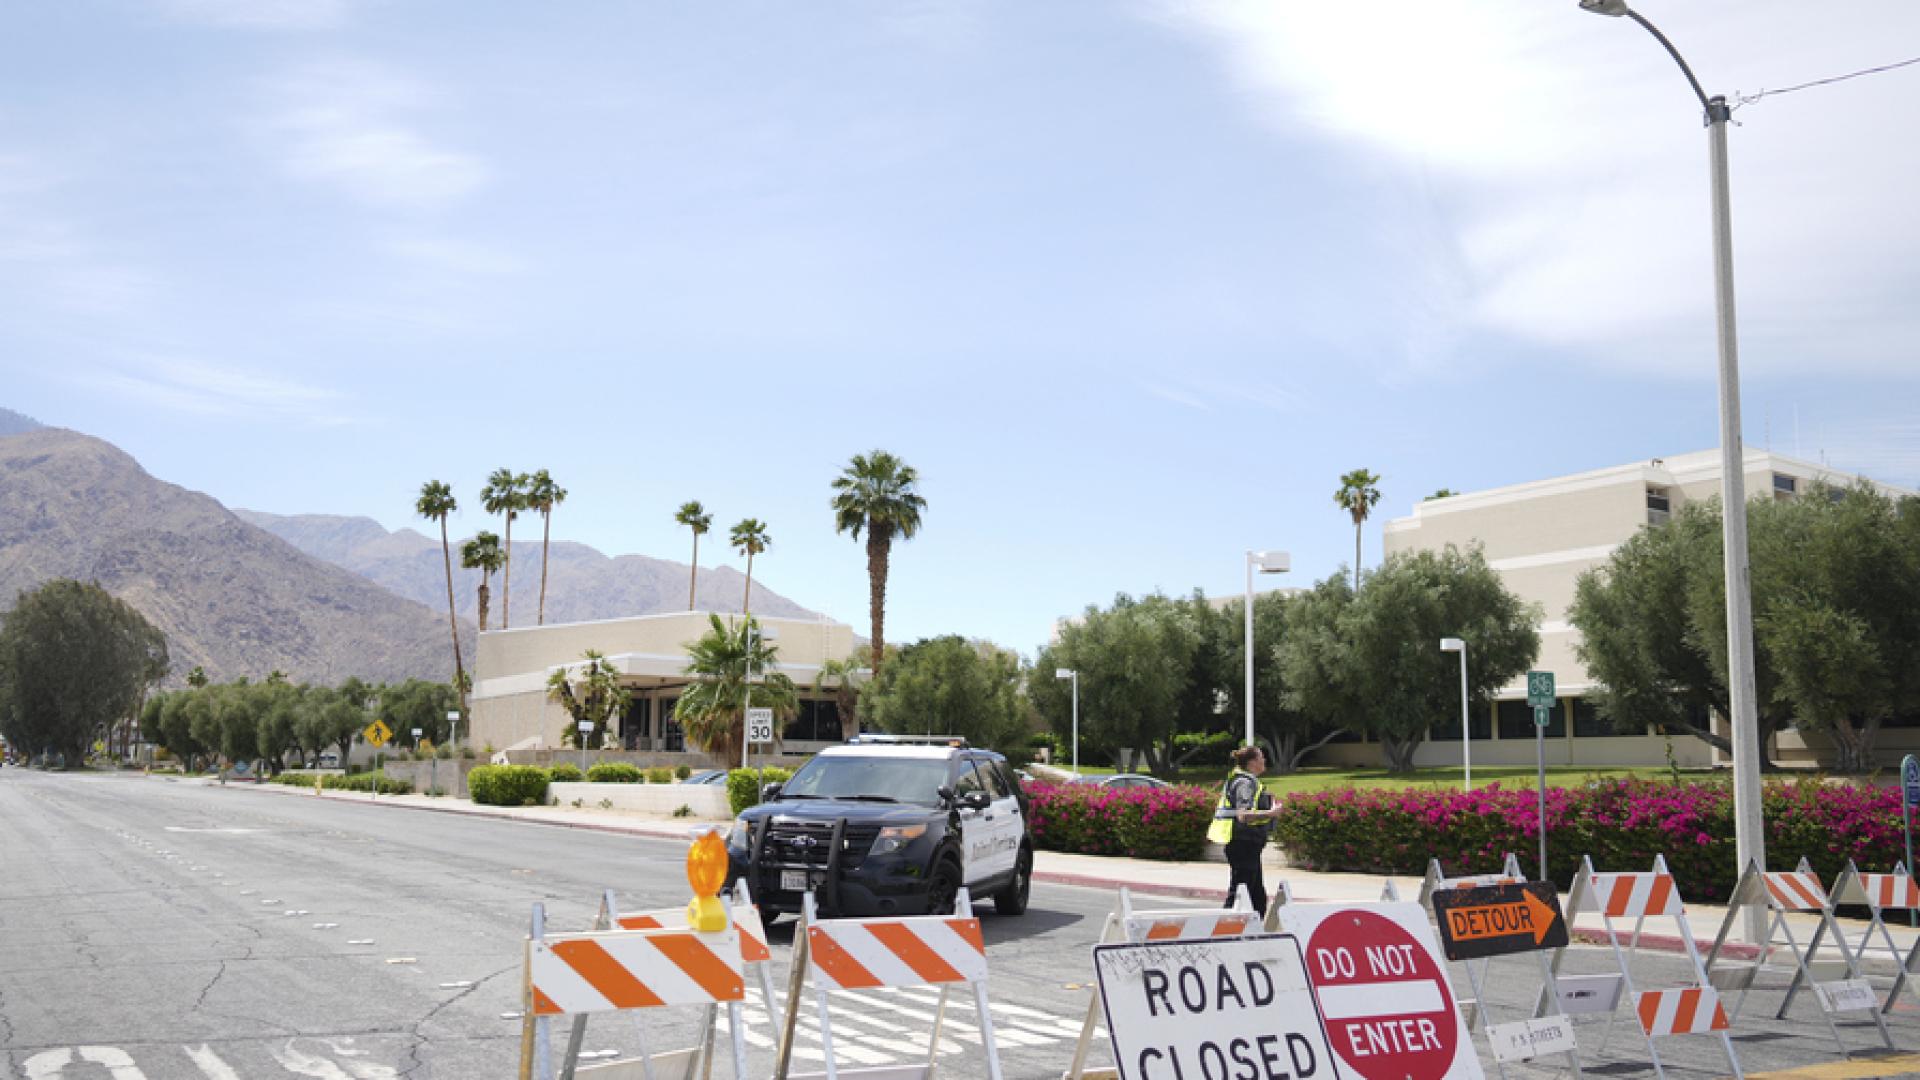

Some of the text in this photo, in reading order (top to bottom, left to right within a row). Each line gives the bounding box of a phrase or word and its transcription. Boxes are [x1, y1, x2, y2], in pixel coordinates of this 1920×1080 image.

[751, 725, 770, 740] 30
[1452, 905, 1535, 936] DETOUR
[1316, 944, 1416, 979] DO NOT
[1143, 962, 1275, 1016] ROAD
[1346, 1019, 1442, 1056] ENTER
[1139, 1032, 1317, 1080] CLOSED
